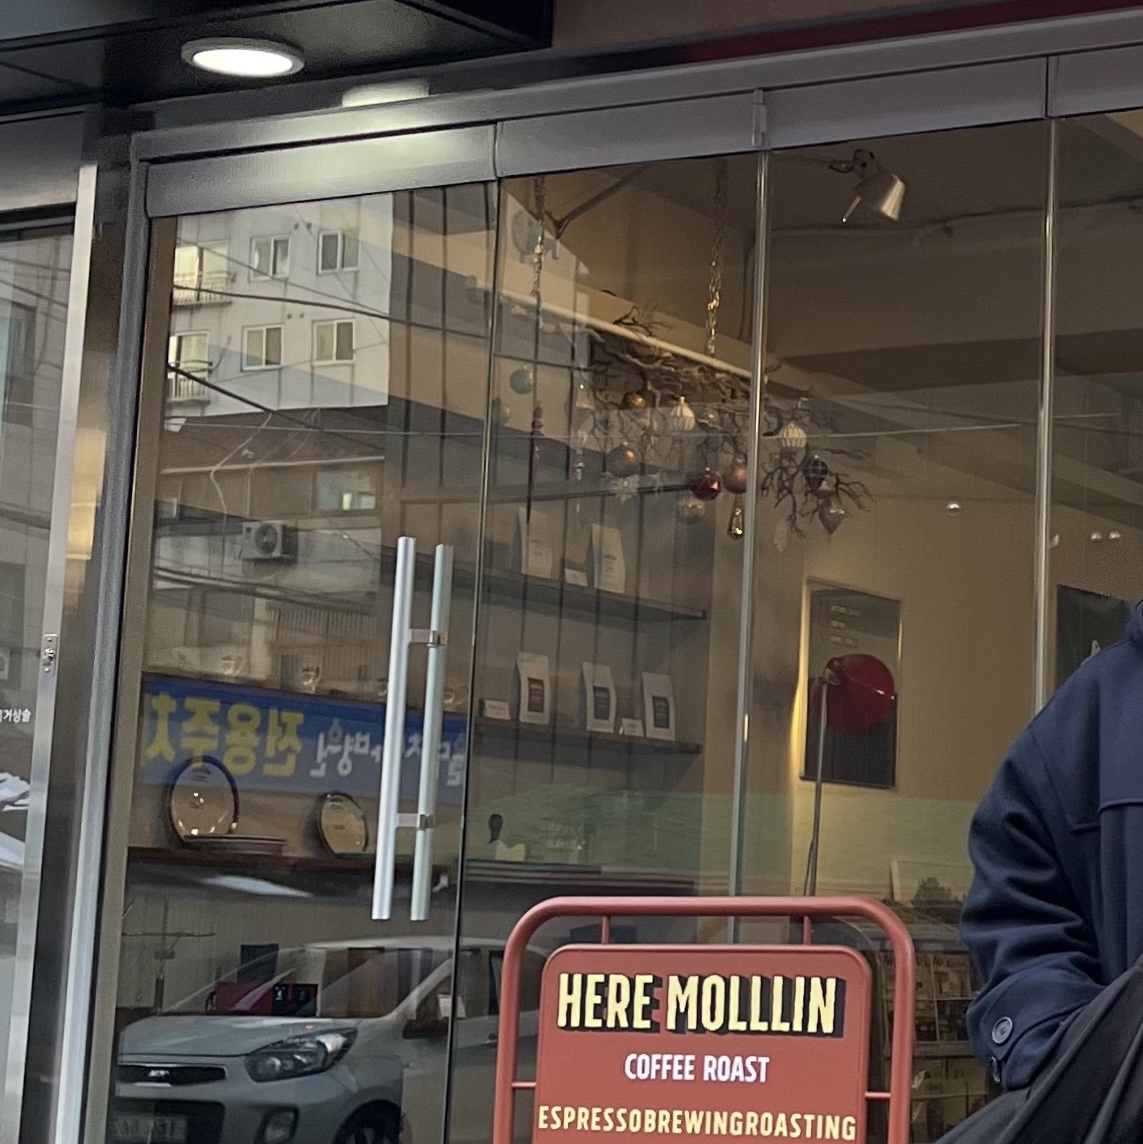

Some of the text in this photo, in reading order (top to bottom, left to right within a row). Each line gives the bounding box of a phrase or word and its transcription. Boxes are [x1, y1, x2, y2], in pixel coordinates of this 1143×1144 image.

[0, 707, 31, 723] 거상술
[556, 972, 843, 1036] HERE MOLLLIN
[624, 1053, 770, 1083] COFFEE ROAST
[538, 1105, 856, 1141] ESPRESSOBREWINGROASTING
